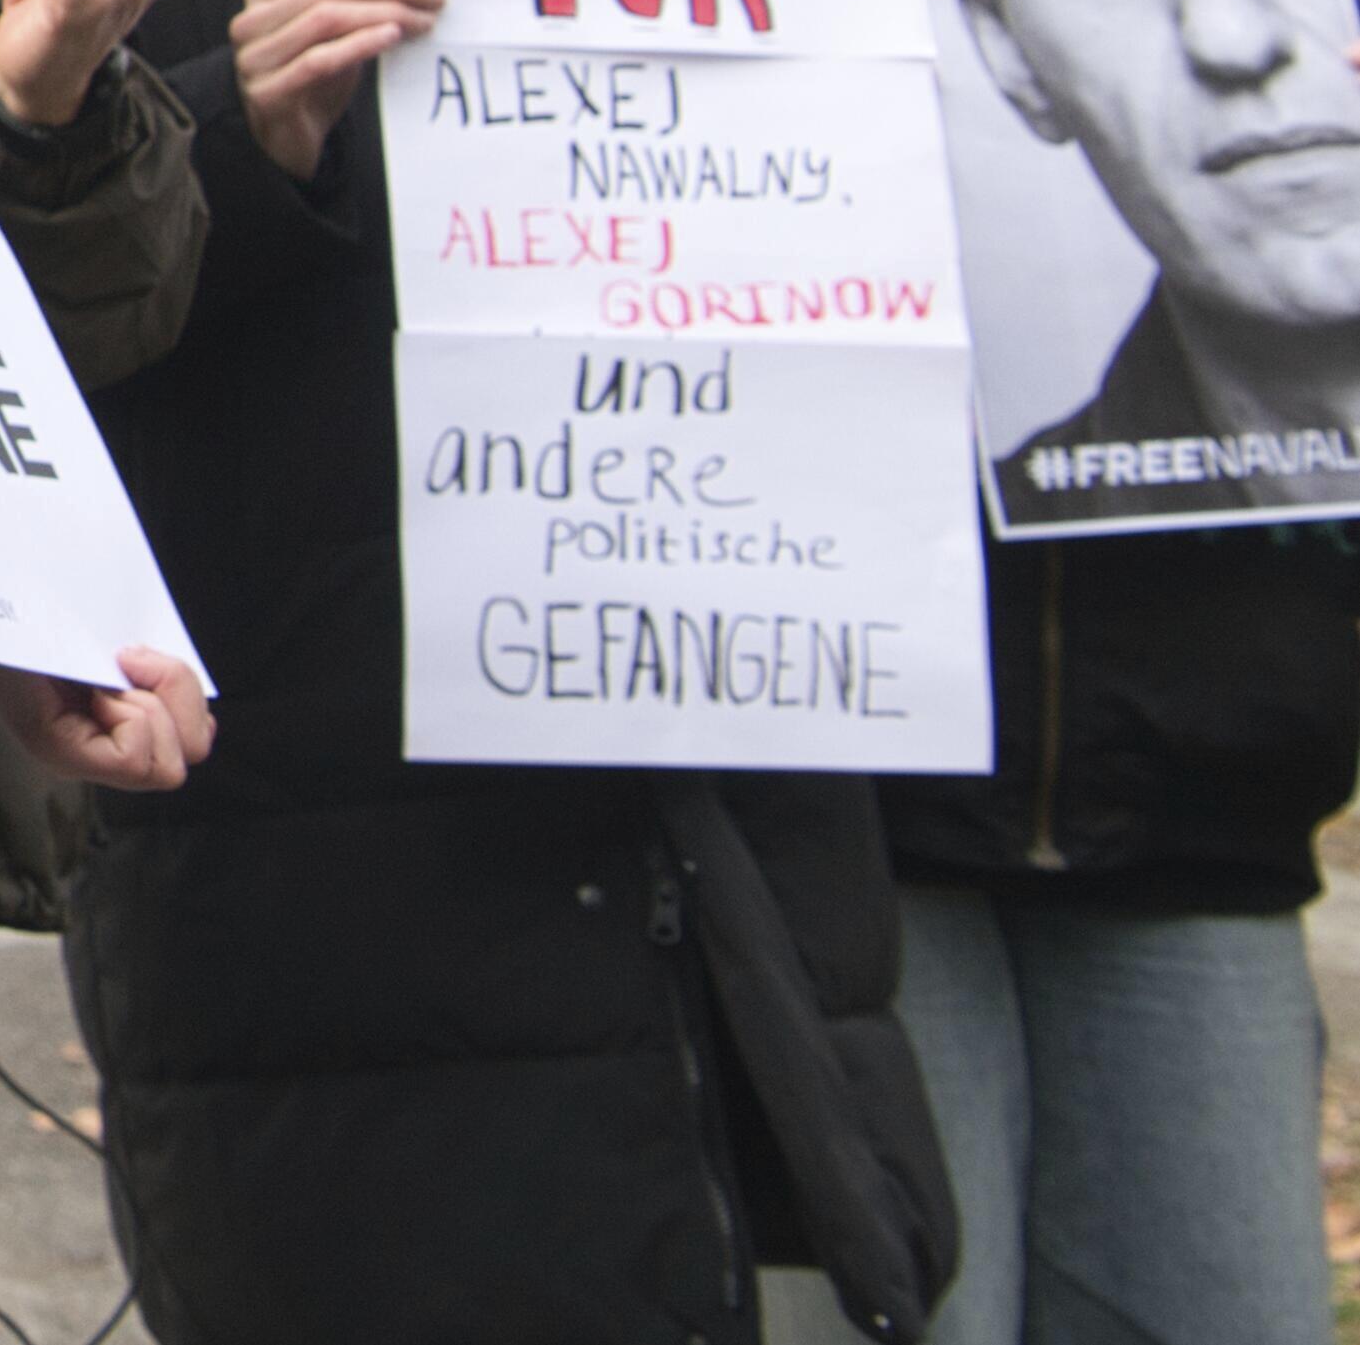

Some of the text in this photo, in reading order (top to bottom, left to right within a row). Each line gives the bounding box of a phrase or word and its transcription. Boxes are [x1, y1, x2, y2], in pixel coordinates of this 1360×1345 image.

[430, 55, 683, 137] ALEXEJ
[439, 205, 677, 272] ALEXEJ
[598, 277, 937, 331] GORINOW
[573, 349, 732, 416] und
[1026, 427, 1360, 491] #FREENAVAL
[477, 595, 910, 719] GEFANGENE
